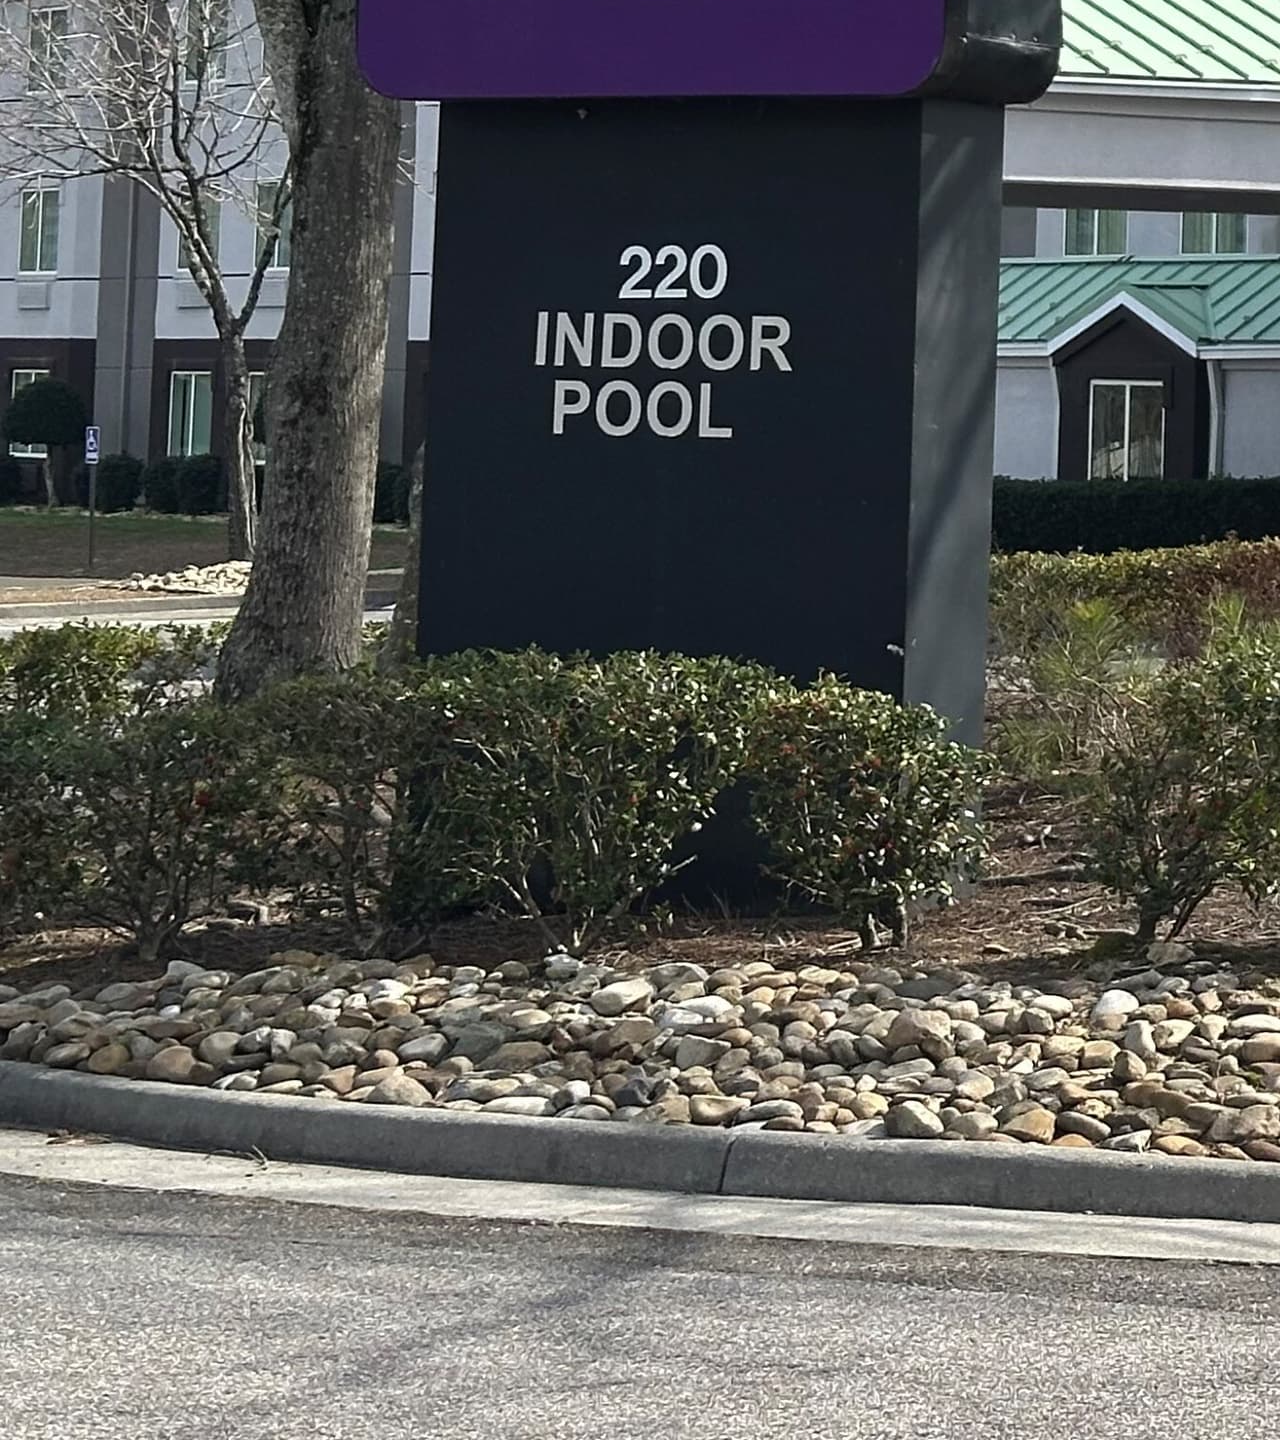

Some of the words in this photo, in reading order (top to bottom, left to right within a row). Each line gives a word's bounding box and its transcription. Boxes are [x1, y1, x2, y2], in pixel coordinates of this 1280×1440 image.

[618, 243, 728, 299] 220
[534, 311, 793, 372] INDOOR
[552, 379, 733, 438] POOL
